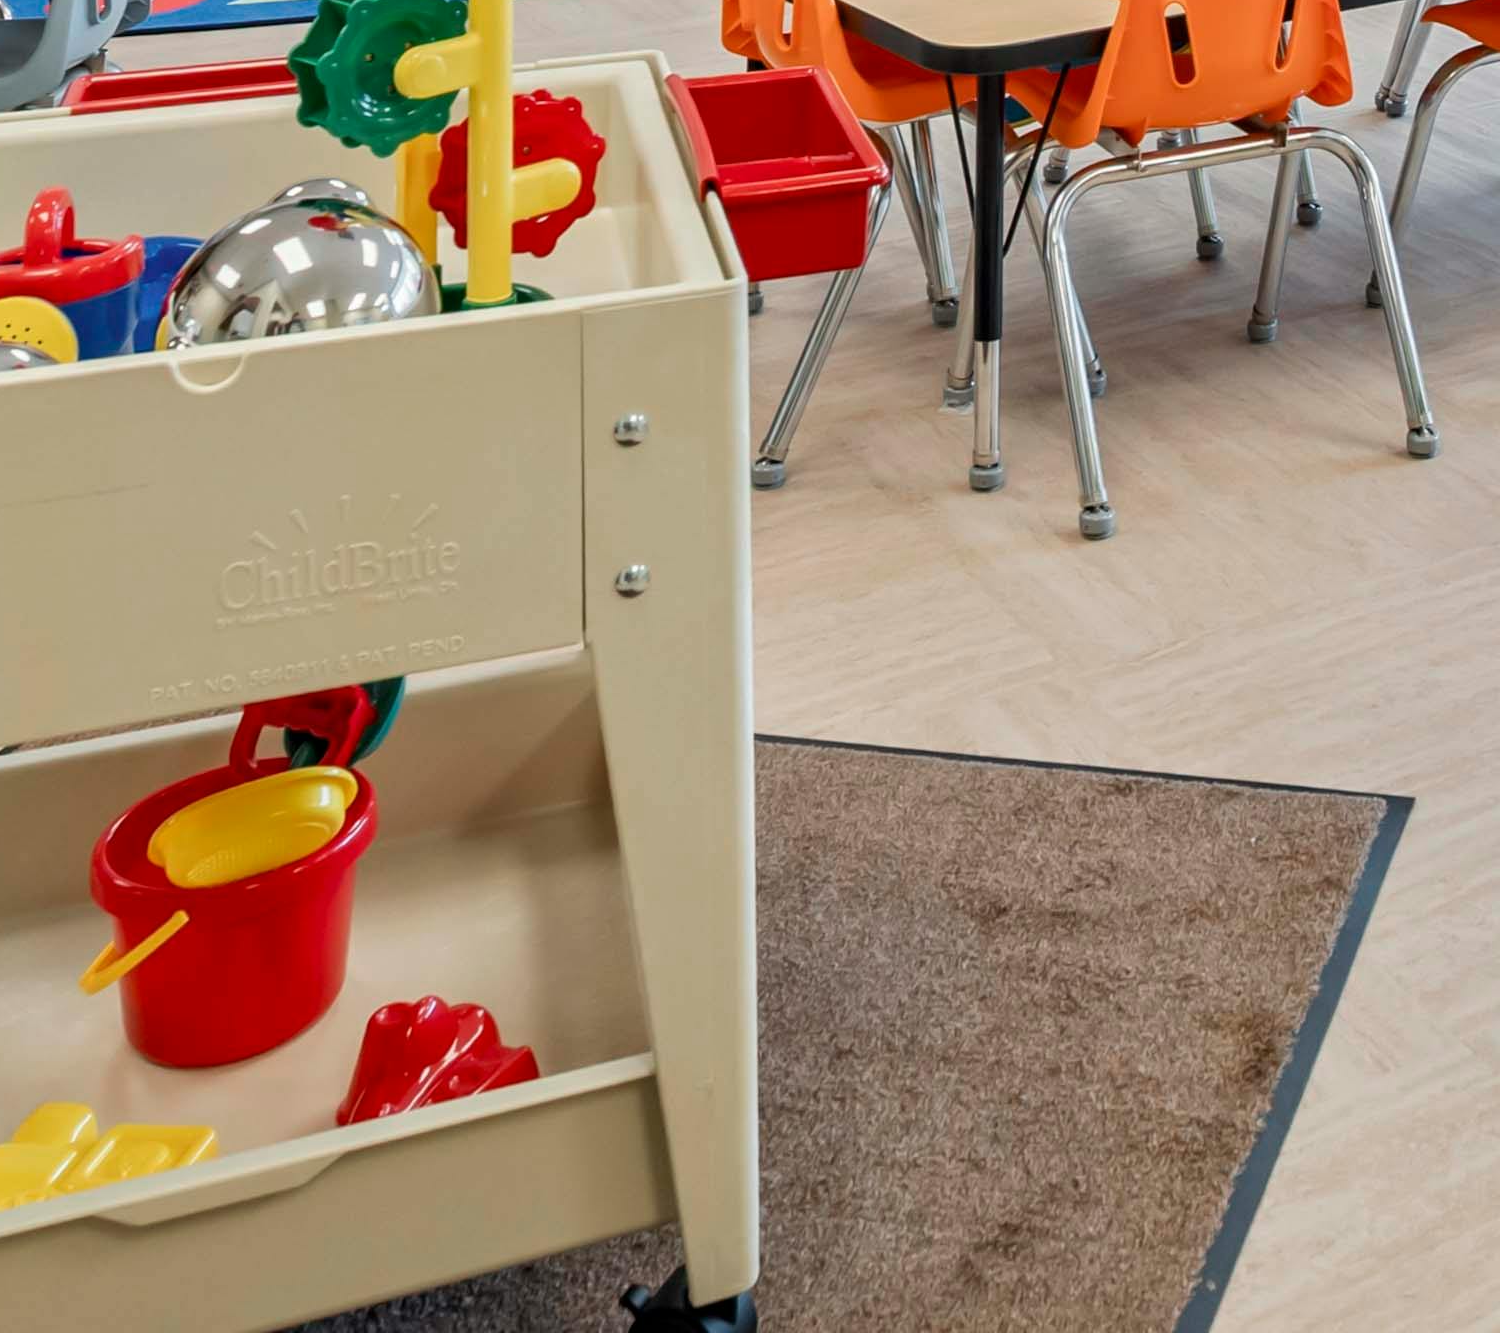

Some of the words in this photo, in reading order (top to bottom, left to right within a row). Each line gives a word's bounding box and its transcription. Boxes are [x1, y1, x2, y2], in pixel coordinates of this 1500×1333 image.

[219, 537, 462, 612] ChildBrite
[150, 677, 195, 704] PAT.
[204, 672, 242, 696] NO.
